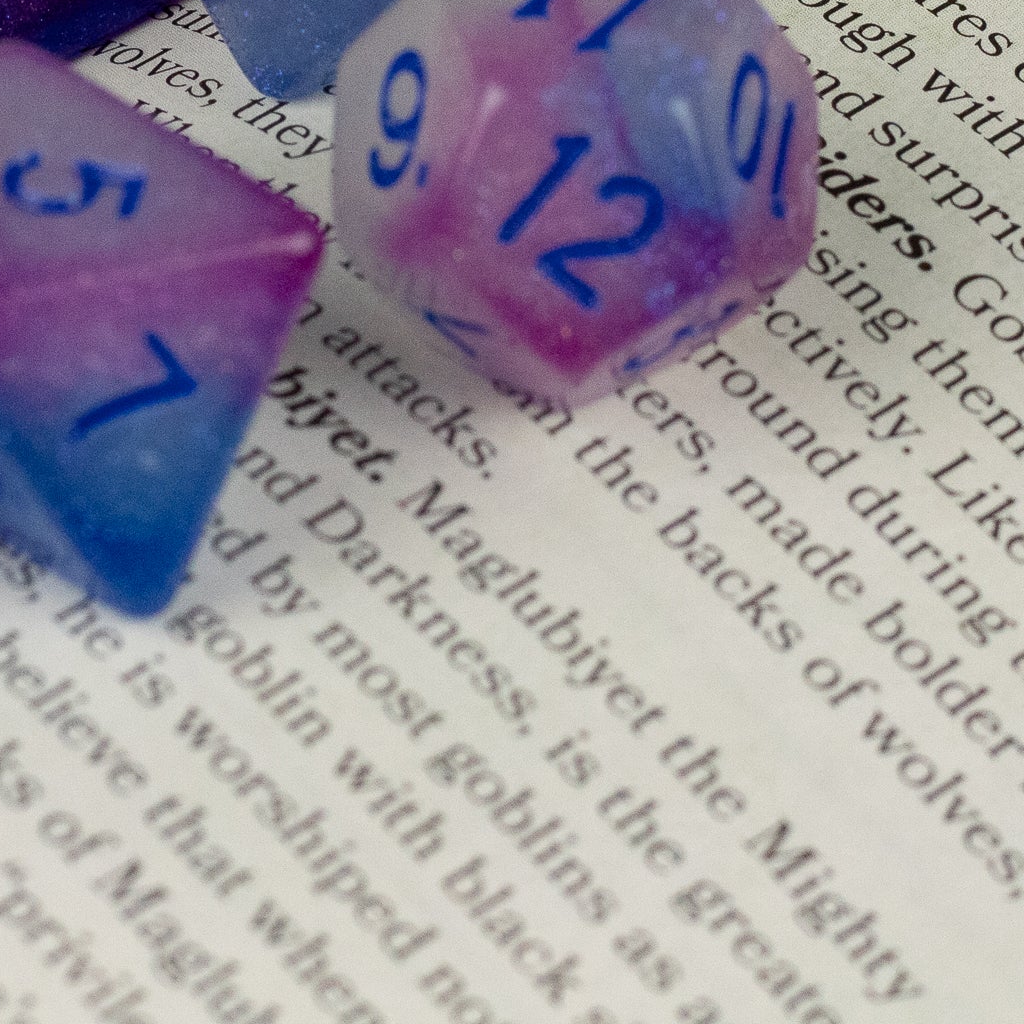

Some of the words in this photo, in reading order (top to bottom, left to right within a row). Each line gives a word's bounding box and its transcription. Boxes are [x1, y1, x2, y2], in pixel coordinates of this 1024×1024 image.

[232, 96, 333, 160] they
[497, 133, 666, 310] 12
[63, 327, 202, 443] 7
[764, 298, 925, 455] ctively.
[805, 229, 920, 344] sing
[321, 326, 499, 480] attacks.
[684, 342, 861, 478] round
[847, 483, 1018, 648] during
[233, 445, 320, 506] nd
[543, 727, 602, 790] is
[595, 785, 688, 878] the
[573, 434, 660, 514] the
[657, 505, 805, 655] backs
[801, 656, 882, 709] of
[616, 378, 716, 474] ers,
[725, 475, 866, 606] made
[862, 597, 1024, 761] bolder
[37, 809, 123, 865] of
[118, 651, 175, 711] is
[174, 705, 443, 964] worshiped
[143, 793, 256, 900] that
[163, 601, 334, 749] goblin
[332, 744, 448, 866] with
[439, 850, 582, 1013] black
[250, 552, 324, 621] by
[312, 619, 448, 744] most
[422, 739, 623, 929] goblins
[607, 924, 687, 1000] as
[395, 480, 667, 736] Maglubiyet
[659, 734, 749, 824] the
[742, 817, 926, 1004] Mighty
